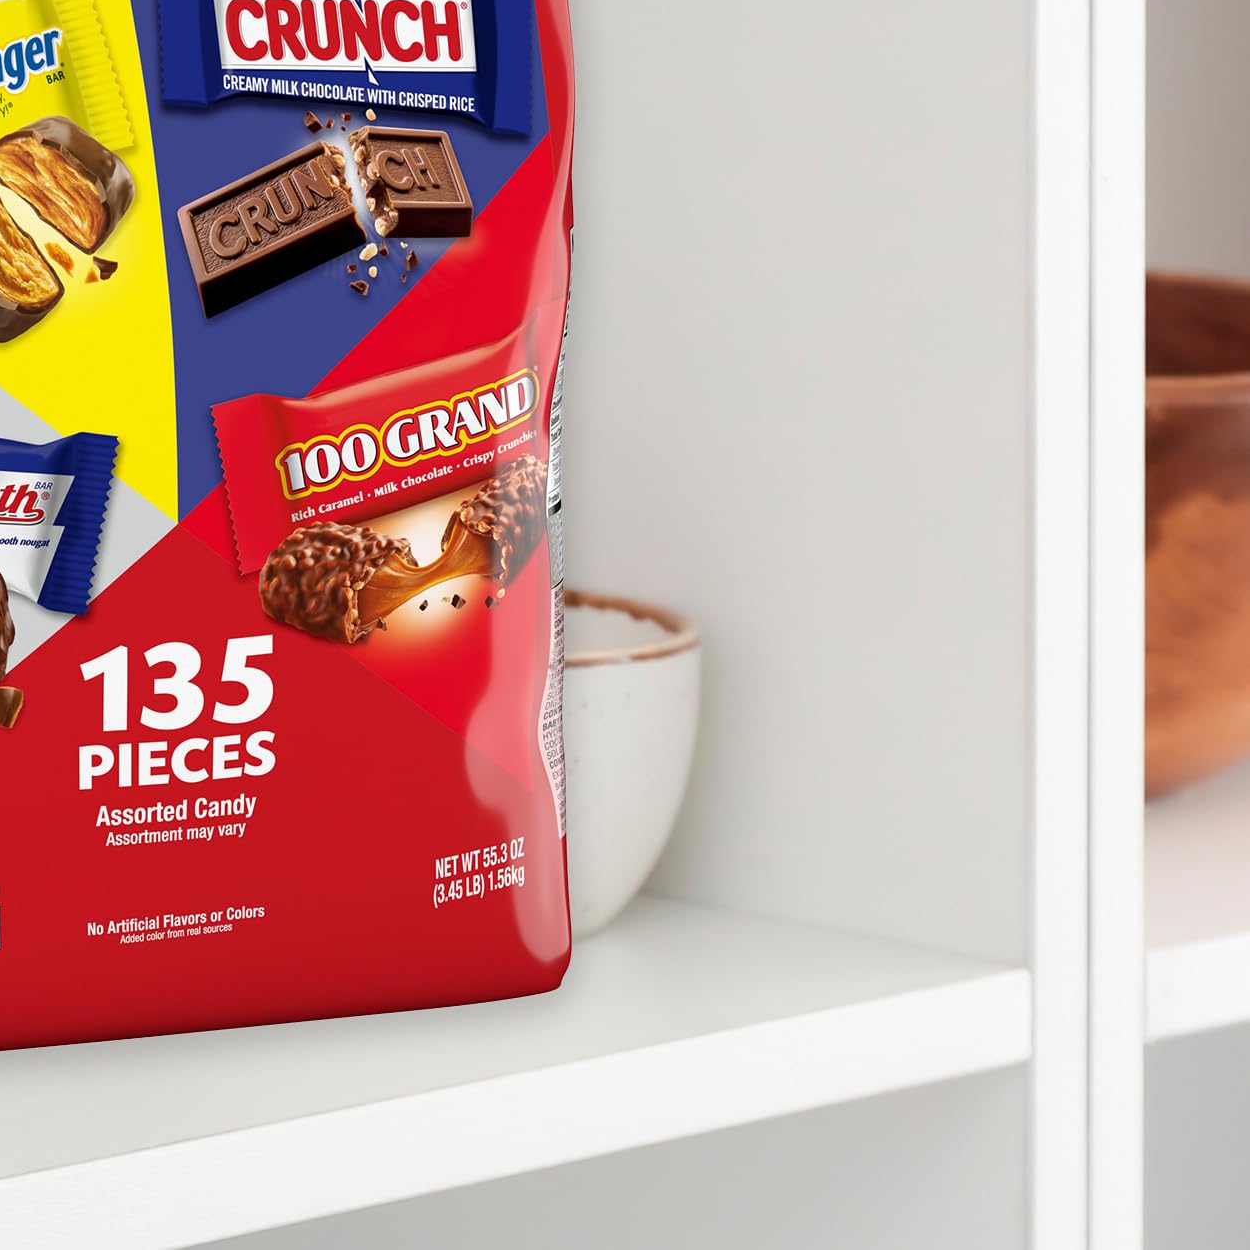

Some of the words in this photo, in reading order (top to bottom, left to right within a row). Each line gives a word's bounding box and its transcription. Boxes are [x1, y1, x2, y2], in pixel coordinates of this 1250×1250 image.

[46, 71, 65, 84] BAR
[223, 74, 269, 93] CREAMY
[271, 78, 299, 96] MILK
[301, 82, 365, 102] CHOCOLATE
[367, 88, 395, 104] WITH
[398, 91, 446, 110] CRISPED
[449, 95, 475, 112] RICE
[210, 161, 333, 259] CRUN
[376, 148, 440, 192] CH
[283, 431, 378, 493] 100
[386, 375, 535, 460] GRAND
[34, 481, 53, 490] BAR
[291, 507, 315, 523] Rich
[318, 491, 364, 514] Caramel
[374, 482, 399, 497] Milk
[401, 465, 453, 489] Chocolate
[463, 450, 495, 469] Crispy
[497, 430, 537, 454] Crunchies
[20, 538, 50, 548] nougat
[80, 634, 274, 732] 135
[79, 730, 276, 791] PIECES
[95, 799, 188, 827] Assorted
[194, 793, 257, 818] Candy
[106, 826, 183, 847] Assortment
[186, 825, 214, 842] may
[218, 822, 246, 837] vary
[435, 855, 459, 879] NET
[461, 850, 480, 873] WT
[483, 843, 508, 868] 55.3
[510, 836, 525, 860] OZ
[433, 879, 463, 909] (3.45
[466, 873, 485, 899] LB)
[488, 865, 525, 891] 1.56kg
[87, 922, 104, 936] No
[107, 916, 160, 935] Artificial
[163, 912, 207, 929] Flavors
[210, 910, 223, 922] or
[226, 906, 265, 920] Colors
[119, 934, 144, 945] Added
[146, 930, 165, 941] color
[167, 929, 185, 940] from
[186, 926, 201, 936] real
[203, 924, 233, 935] sources
